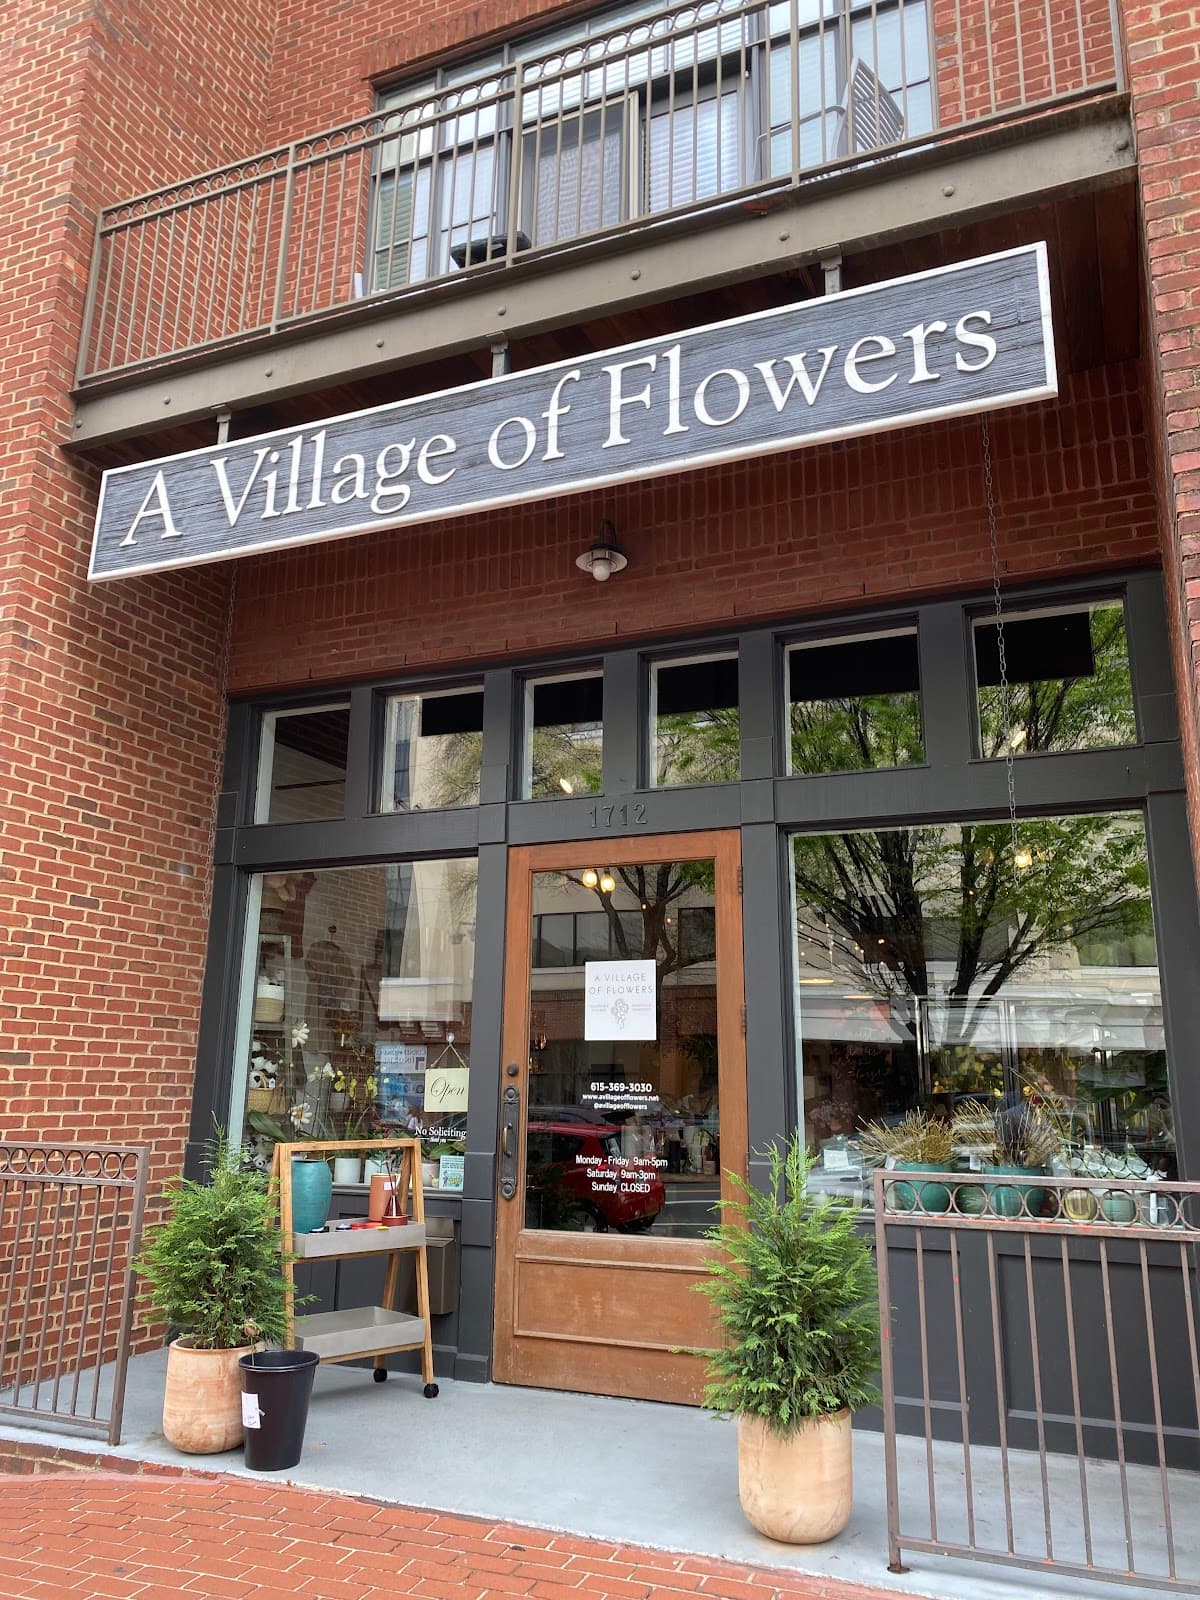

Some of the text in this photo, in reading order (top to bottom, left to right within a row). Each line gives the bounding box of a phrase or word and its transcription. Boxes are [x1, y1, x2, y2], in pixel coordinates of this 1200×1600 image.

[119, 309, 999, 548] A Village of Flowers
[586, 803, 648, 829] 1712
[604, 972, 647, 982] VILLAGE
[588, 985, 653, 995] OF FLOWERS
[430, 1076, 465, 1104] Open
[590, 1082, 653, 1093] 615-369-3030
[582, 1093, 660, 1102] www.avillageofflowers.net
[415, 1126, 467, 1141] No Soliciting
[575, 1154, 602, 1166] Monday
[607, 1155, 629, 1167] Friday
[633, 1156, 668, 1168] 9am-5pm
[586, 1168, 656, 1181] Saturday 9am-3pm
[591, 1181, 650, 1193] Sunday CLOSED
